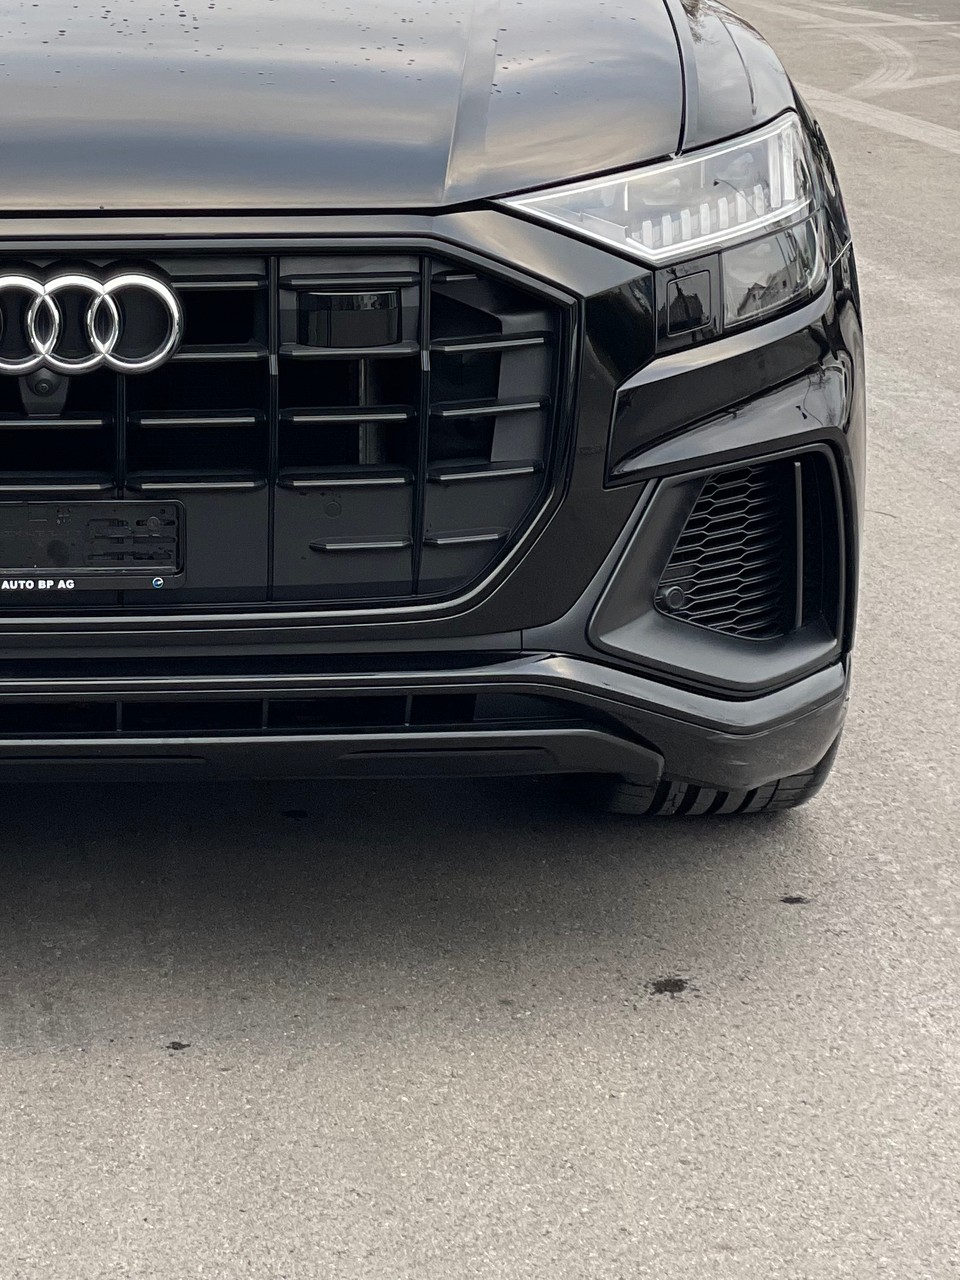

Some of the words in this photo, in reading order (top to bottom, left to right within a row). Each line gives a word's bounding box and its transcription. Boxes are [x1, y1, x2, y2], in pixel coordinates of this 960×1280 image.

[1, 580, 35, 590] AUTO
[37, 579, 54, 589] BP
[57, 579, 75, 589] AG
